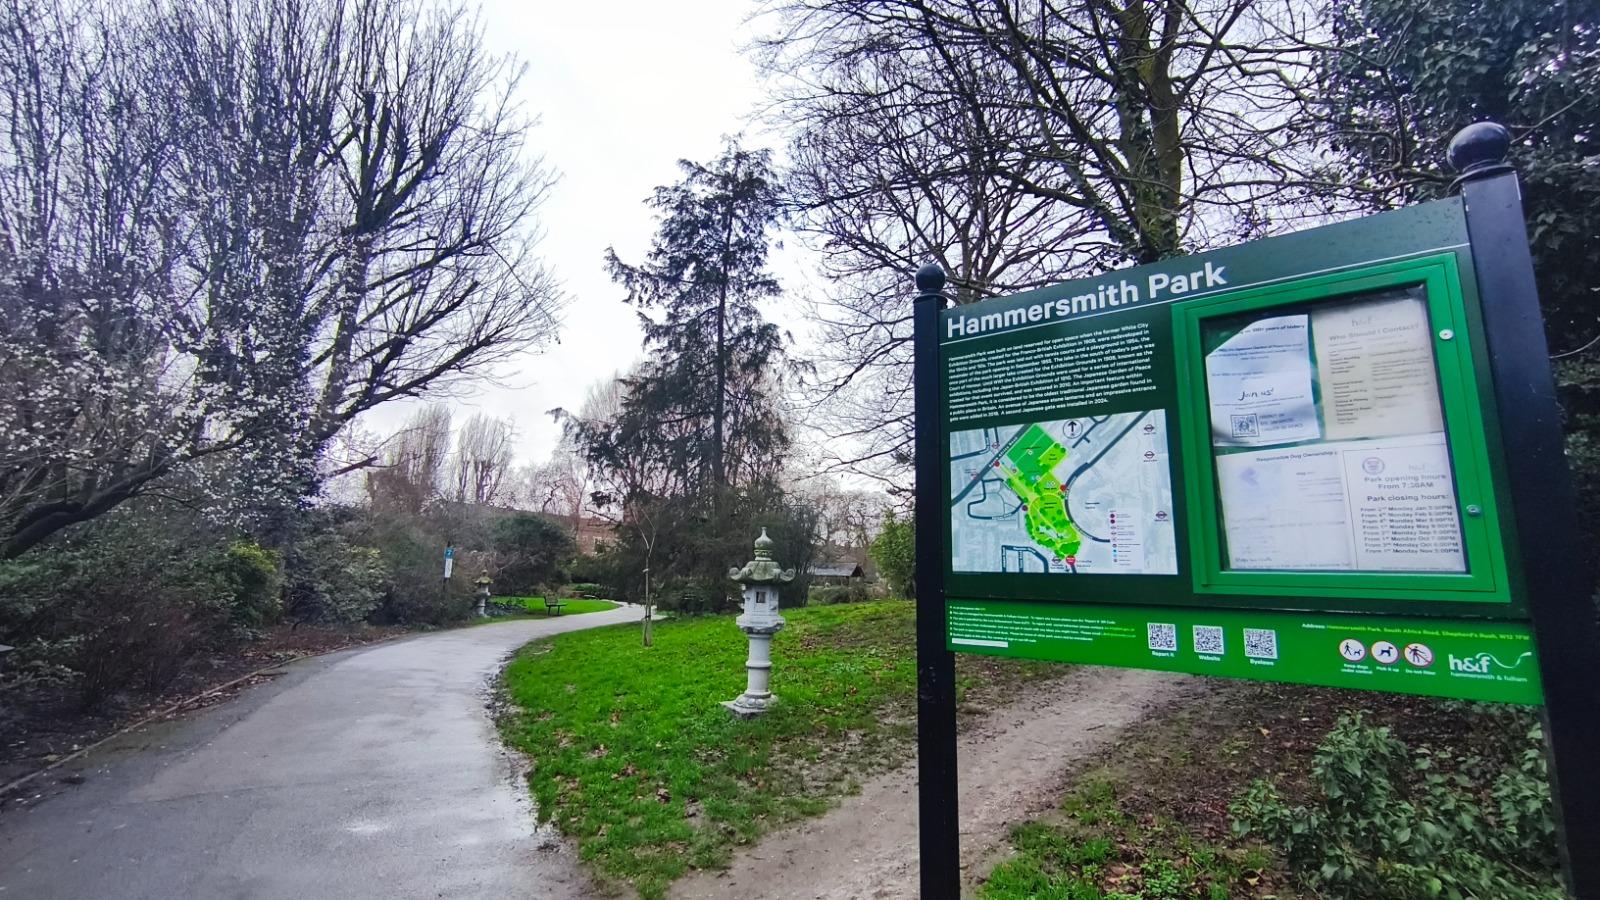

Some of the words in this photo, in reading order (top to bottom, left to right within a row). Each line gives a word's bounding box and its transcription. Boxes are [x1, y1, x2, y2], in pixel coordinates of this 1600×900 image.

[948, 280, 1138, 338] Hammersmith
[1149, 262, 1227, 298] Park
[1348, 329, 1376, 337] Should
[1448, 654, 1490, 673] h&f
[1450, 671, 1495, 680] hammersmith
